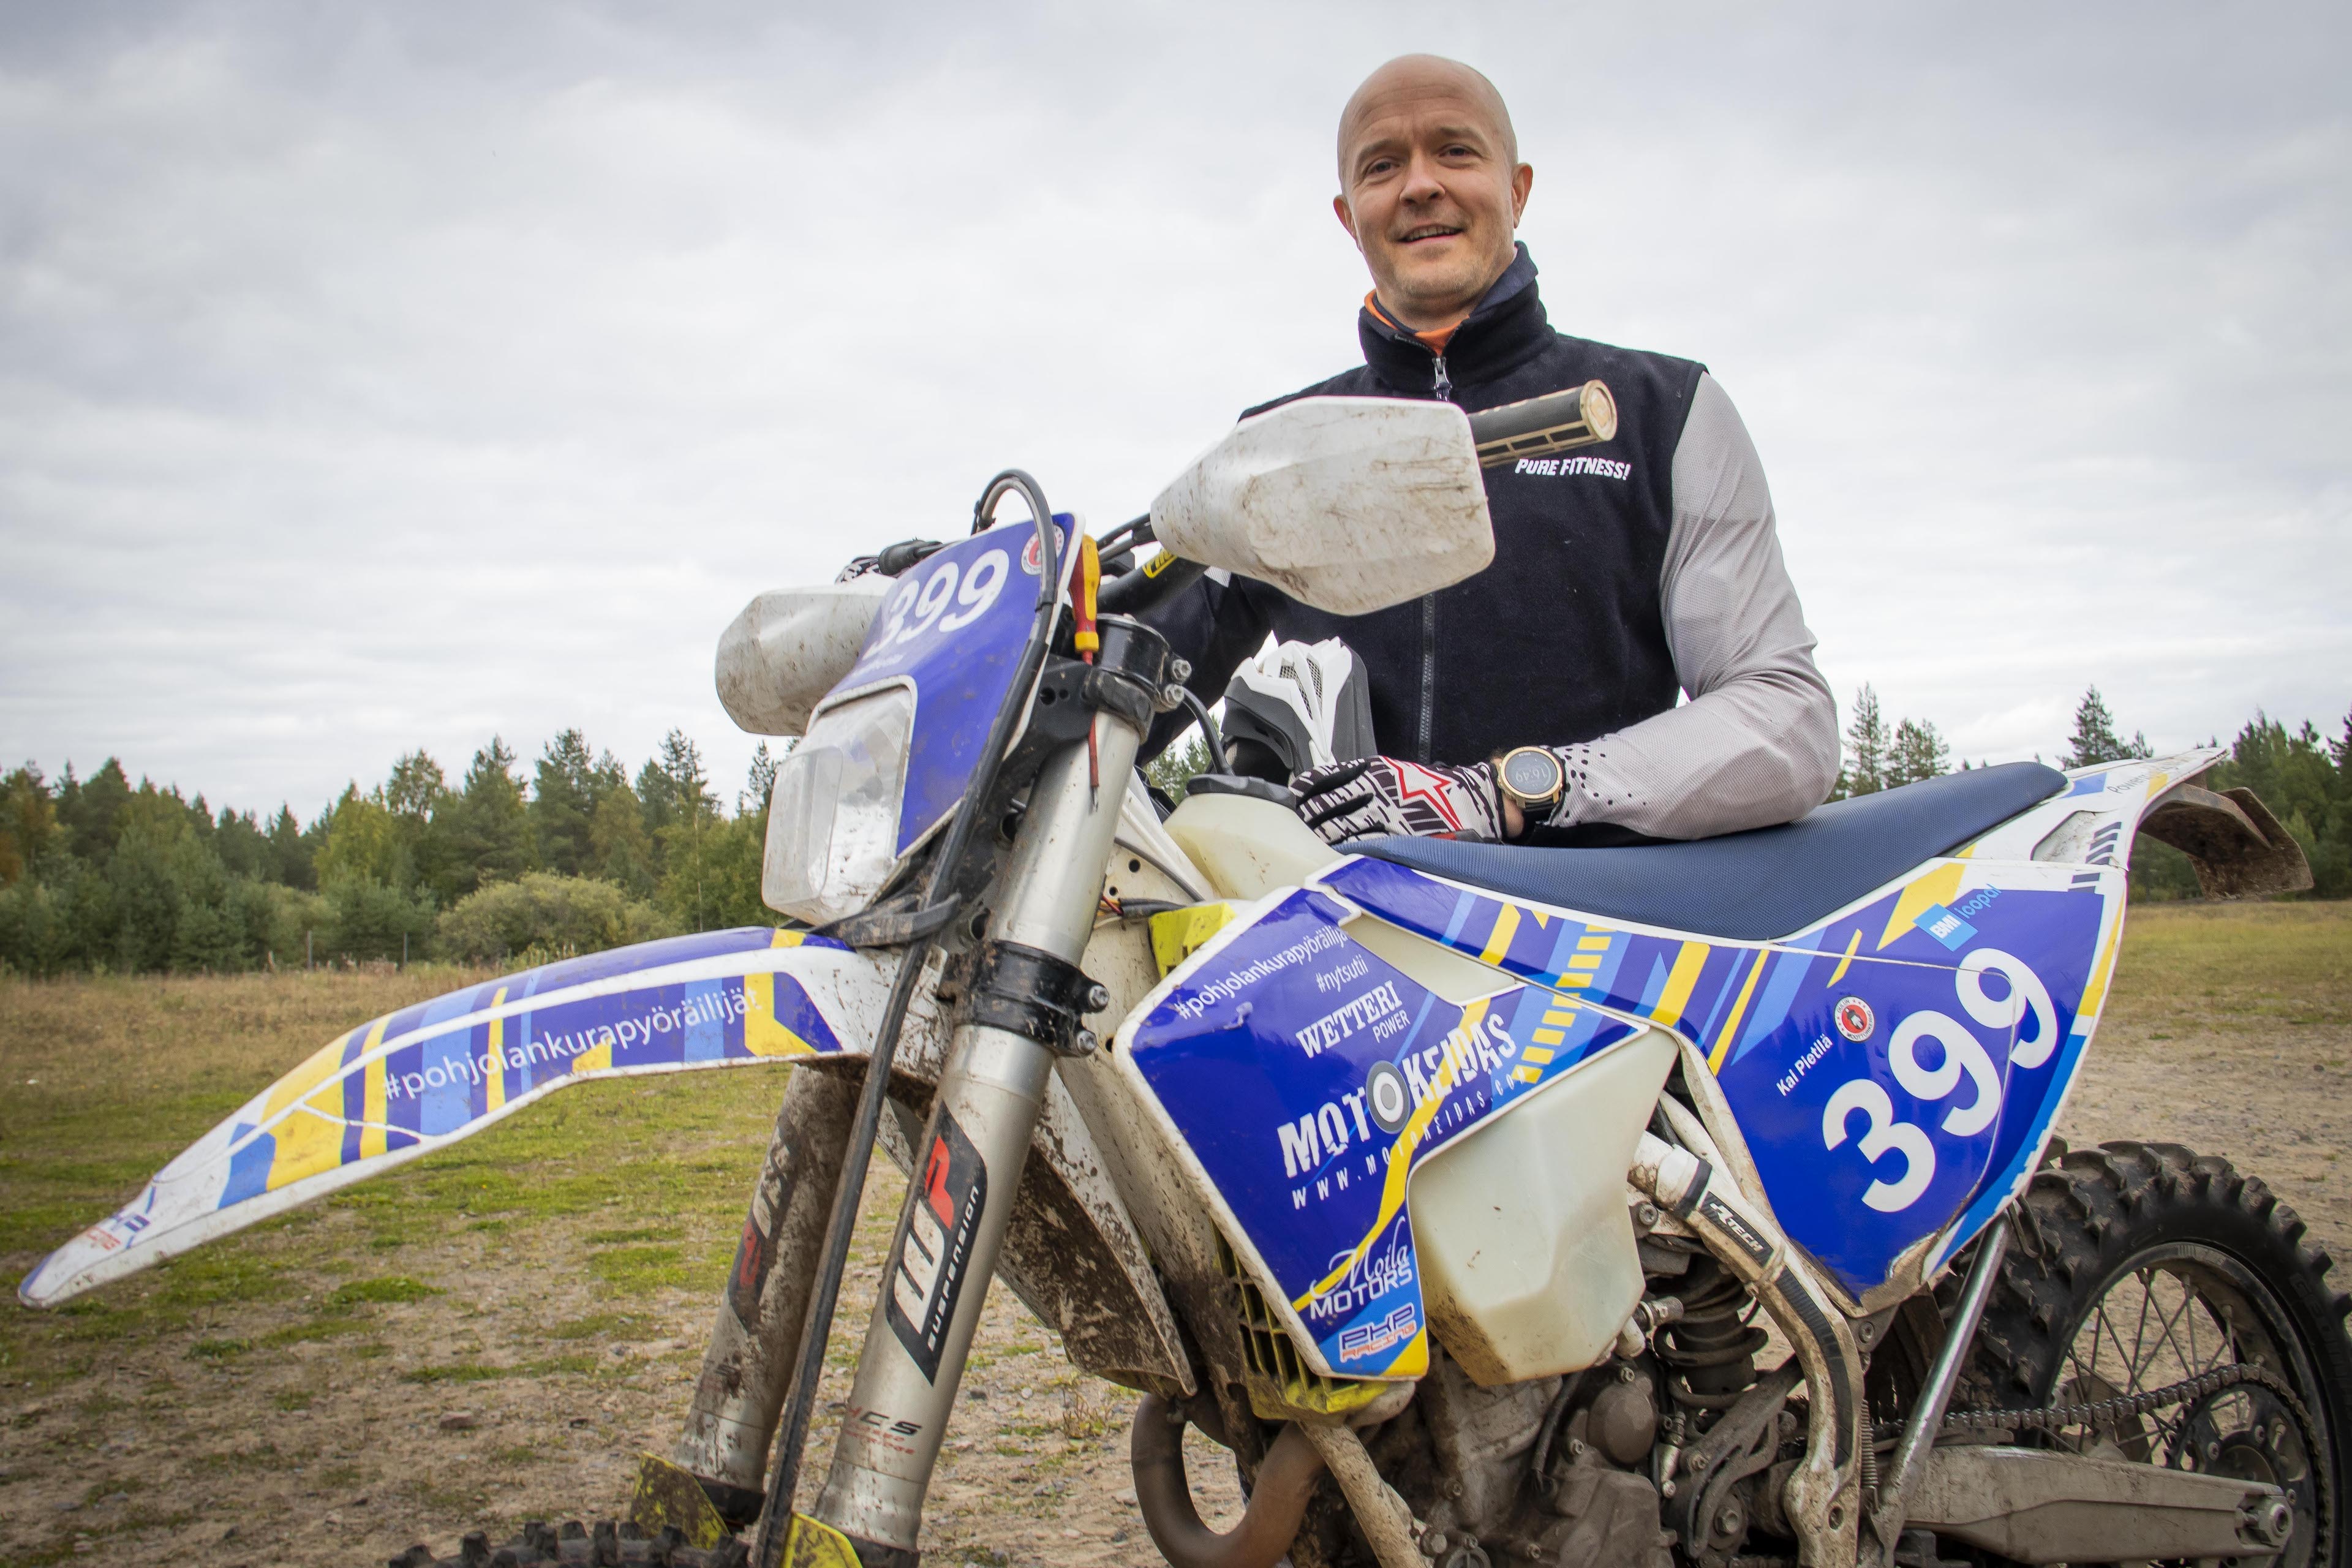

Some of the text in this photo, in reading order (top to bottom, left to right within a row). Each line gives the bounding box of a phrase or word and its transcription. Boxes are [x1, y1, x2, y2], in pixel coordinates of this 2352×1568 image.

[1515, 457, 1631, 481] PURE FITNESS!
[862, 549, 1009, 660] 399
[1929, 914, 1962, 939] BMI
[1316, 953, 1369, 993] #nytsutii
[1295, 980, 1402, 1058] WETTERI
[1373, 1009, 1411, 1043] POWER
[1277, 1012, 1517, 1177] MOTOKEIDAS
[1822, 948, 2058, 1213] 399
[1310, 1267, 1413, 1320] MOTORS
